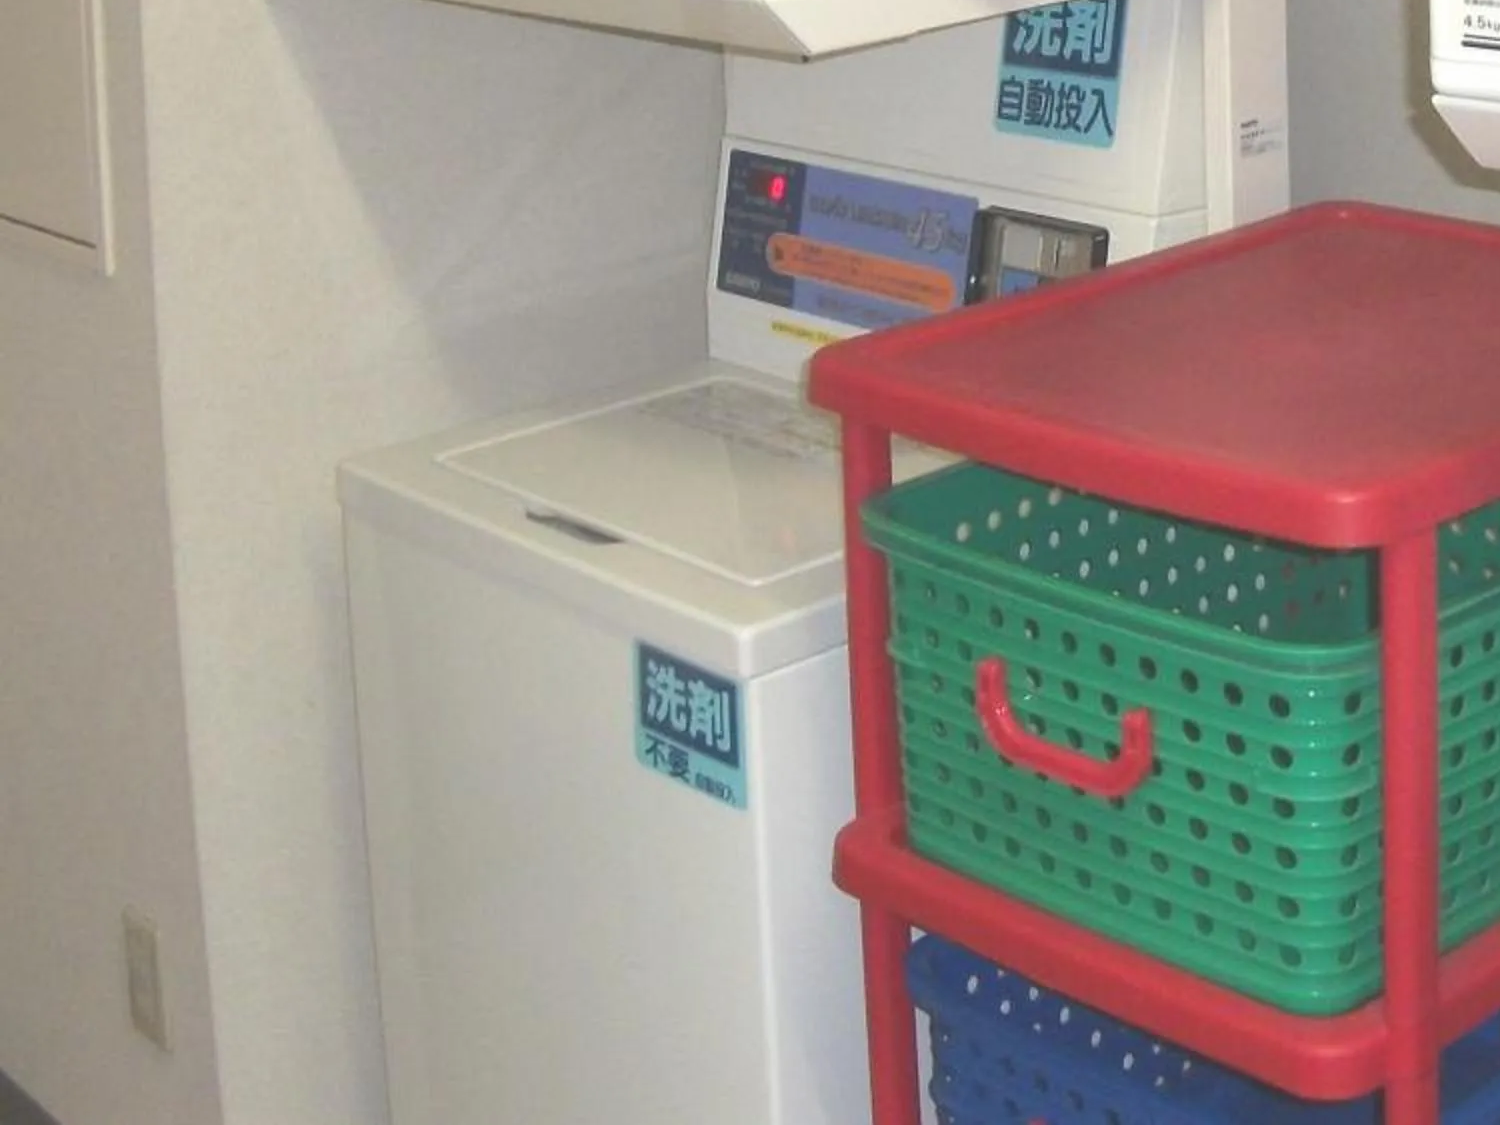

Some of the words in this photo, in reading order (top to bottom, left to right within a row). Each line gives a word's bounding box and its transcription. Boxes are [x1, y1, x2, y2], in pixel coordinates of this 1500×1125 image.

[997, 75, 1113, 138] 自動投入
[768, 176, 785, 199] 0
[646, 659, 731, 753] 洗剤
[645, 733, 691, 784] 不要
